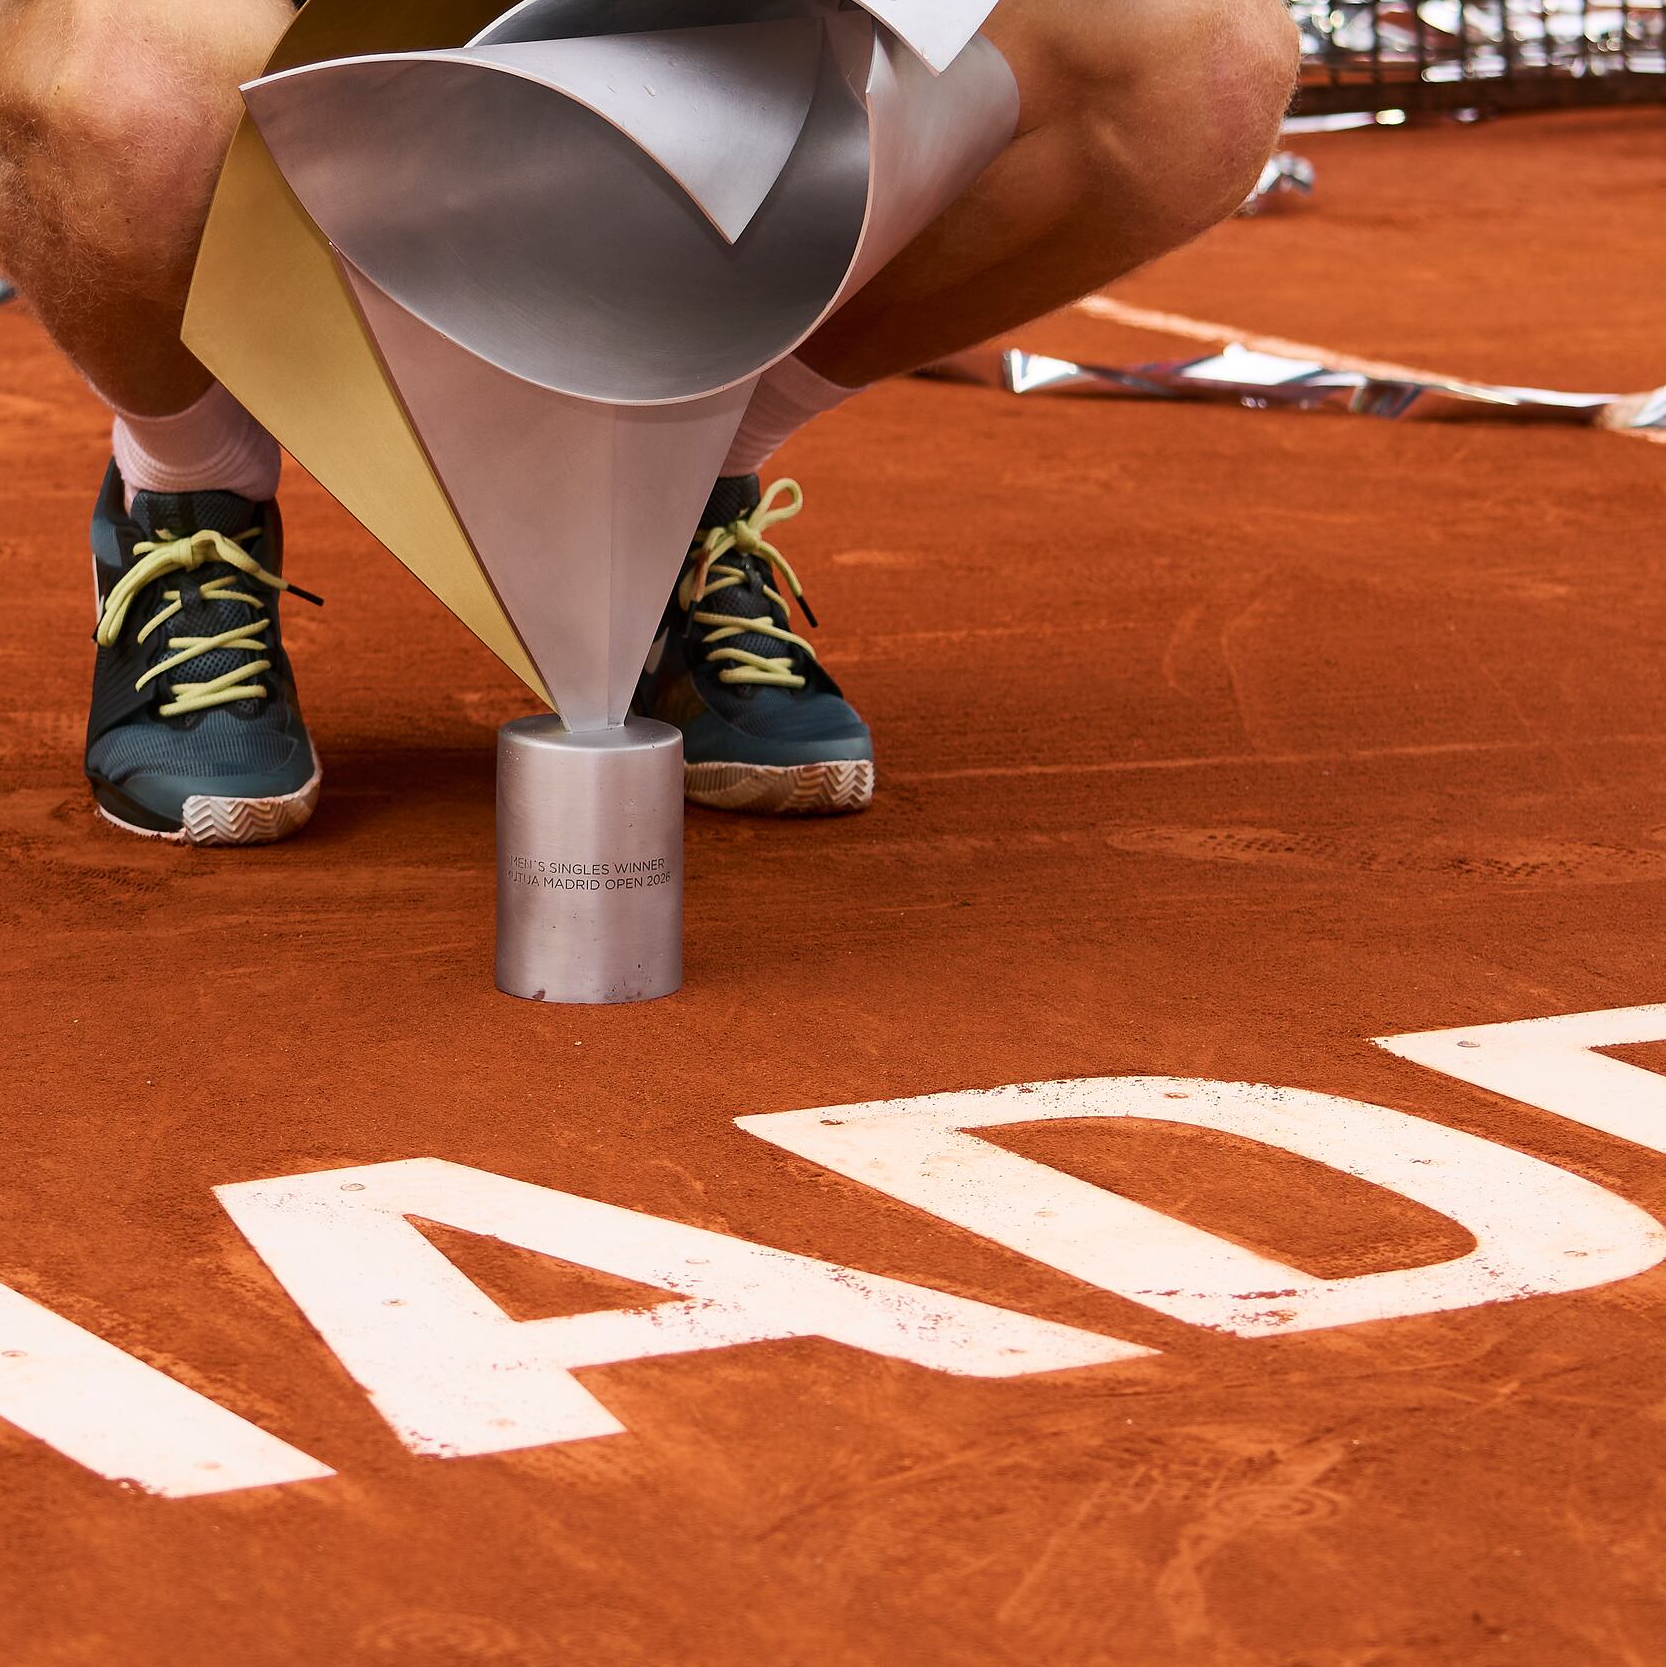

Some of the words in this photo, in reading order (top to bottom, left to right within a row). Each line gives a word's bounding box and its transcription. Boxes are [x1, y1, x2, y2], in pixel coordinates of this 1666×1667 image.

[548, 861, 610, 876] SINGLES
[614, 857, 665, 874] WINNER
[543, 876, 600, 891] MADRID
[604, 876, 643, 890] OPEN
[646, 871, 671, 887] 2026
